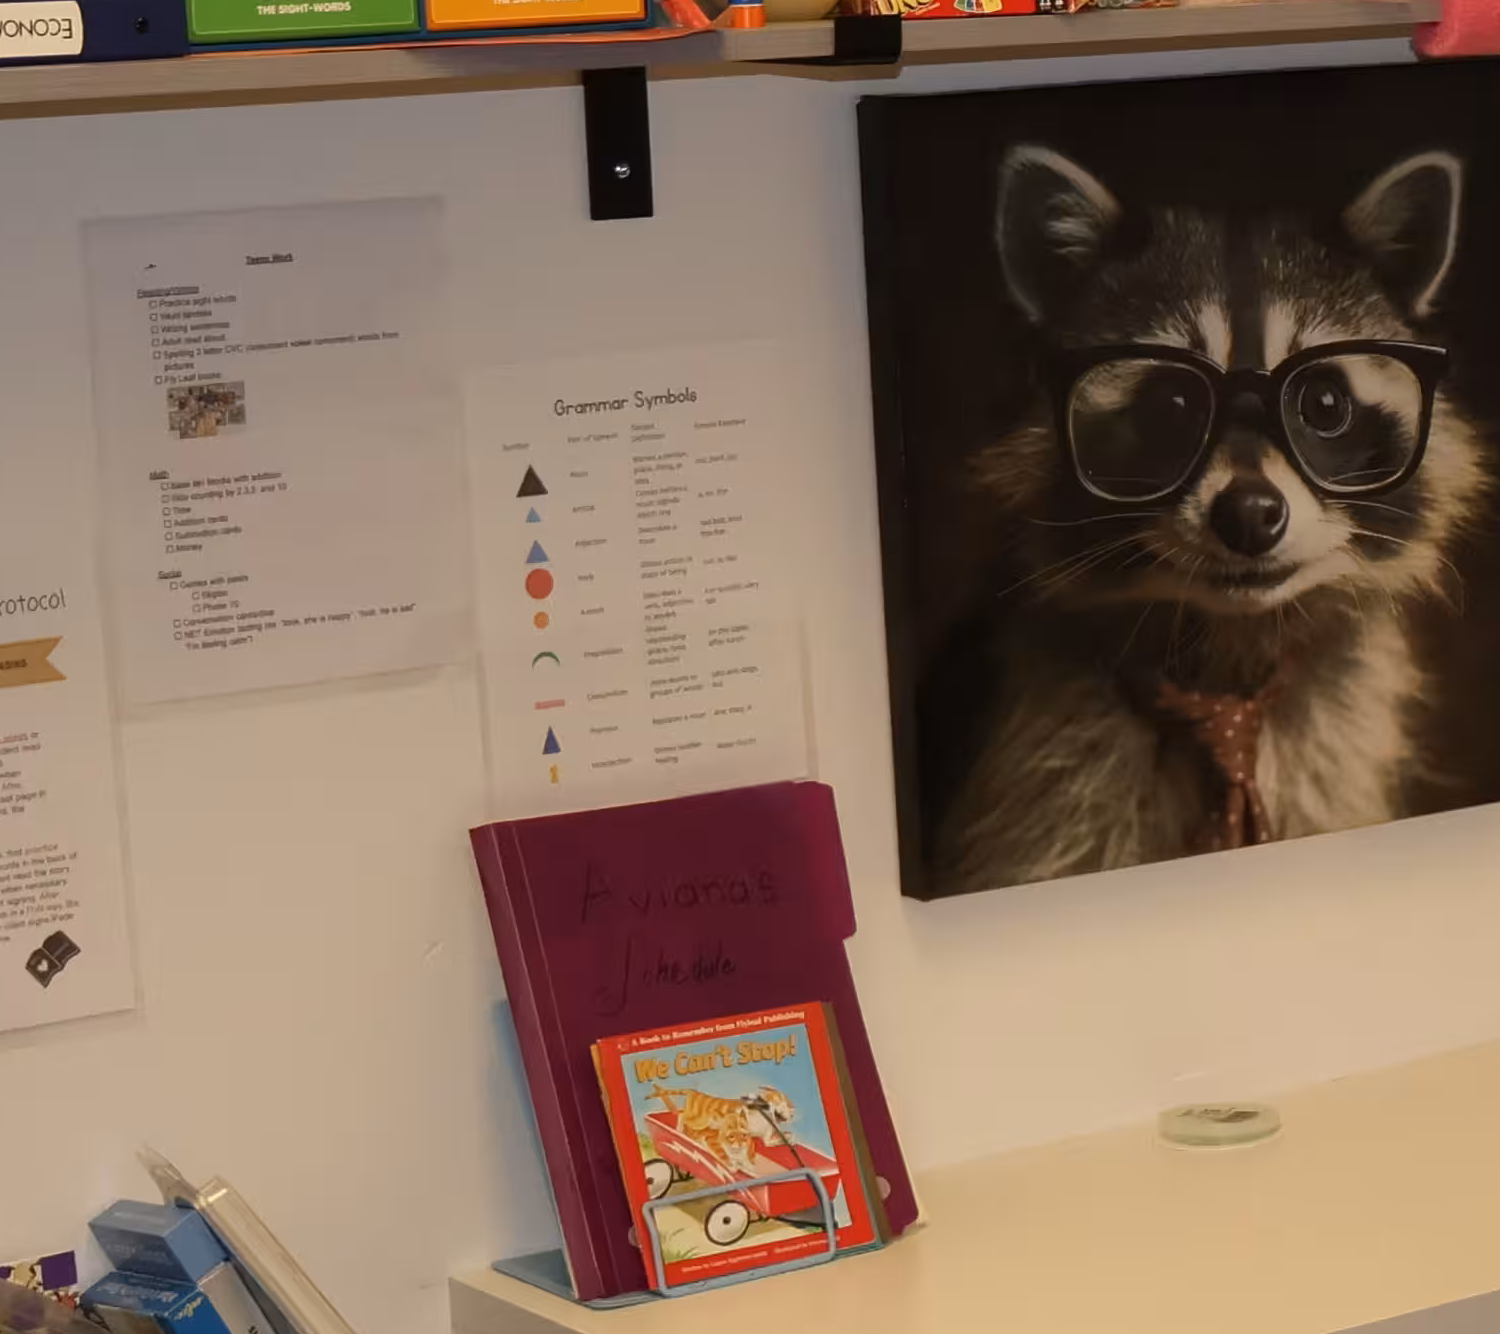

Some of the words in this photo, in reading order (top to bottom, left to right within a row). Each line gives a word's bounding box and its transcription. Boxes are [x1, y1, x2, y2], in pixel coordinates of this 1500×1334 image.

[257, 4, 277, 16] THE
[278, 1, 352, 15] SIGHT-WORDS
[553, 395, 629, 417] Grammar
[633, 387, 698, 411] Symbols
[635, 1059, 669, 1084] We
[673, 1044, 732, 1076] Can't
[736, 1034, 797, 1065] Stop!
